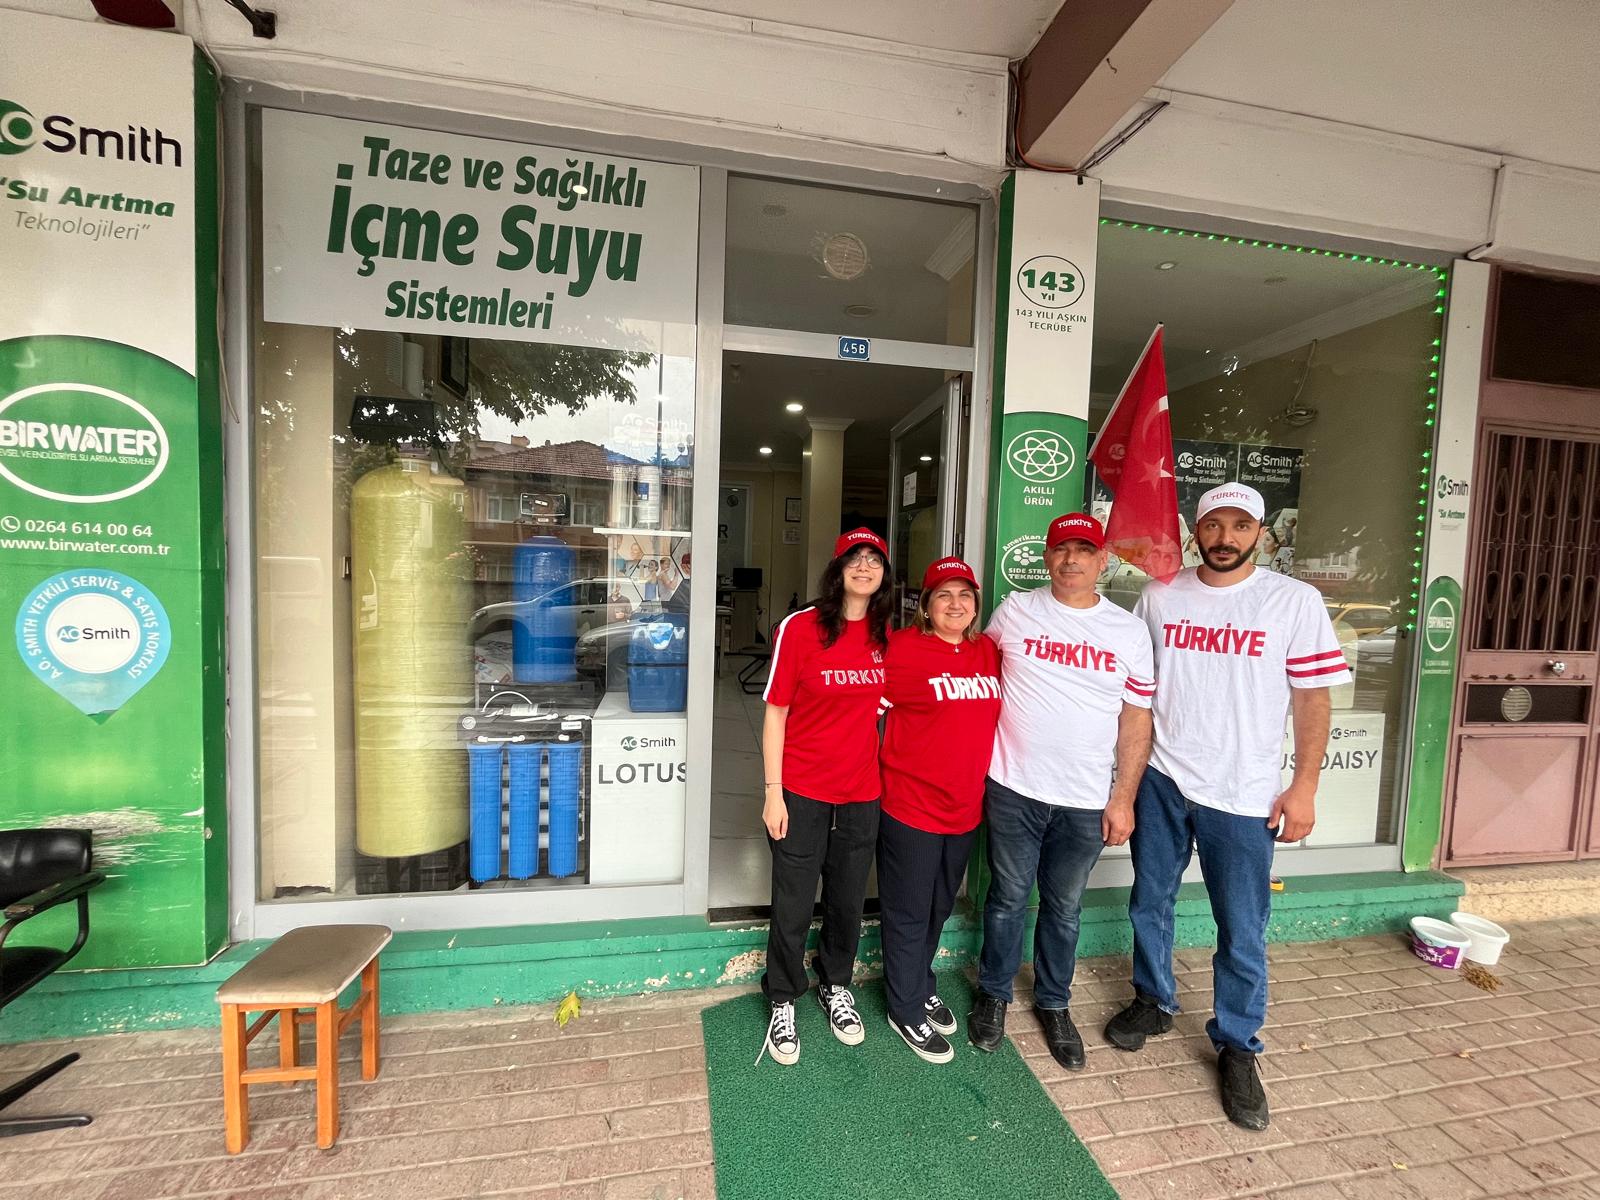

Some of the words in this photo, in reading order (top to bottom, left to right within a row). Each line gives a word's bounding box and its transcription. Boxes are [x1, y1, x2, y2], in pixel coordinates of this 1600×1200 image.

[43, 115, 182, 168] Smith
[363, 135, 452, 185] Taze
[463, 157, 504, 191] ve
[513, 156, 647, 211] Sağlıklı
[58, 186, 176, 217] Arıtma
[327, 163, 480, 277] İçme
[496, 204, 643, 298] Suyu
[1022, 269, 1075, 292] 143
[385, 280, 555, 330] Sistemleri
[1041, 292, 1055, 301] Yıl
[1016, 308, 1033, 317] 143
[1036, 310, 1054, 320] YILI
[1057, 313, 1087, 323] AŞKIN
[1029, 321, 1072, 333] TECRÜBE
[843, 342, 866, 354] 45B
[1195, 455, 1227, 468] Smith
[1262, 454, 1292, 468] Smith
[1023, 485, 1055, 495] AKILLI
[1024, 495, 1053, 506] ÜRÜN
[25, 520, 67, 534] 0264
[72, 523, 103, 535] 614
[107, 524, 128, 536] 00
[132, 525, 153, 538] 64
[0, 538, 171, 556] www.birwater.com.tr
[71, 575, 121, 592] SERVİS
[27, 577, 70, 616] YETKİLİ
[121, 587, 135, 599] &
[132, 596, 160, 628] SATIŞ
[23, 619, 42, 657] SMITH
[82, 628, 131, 640] Smith
[1163, 619, 1266, 657] TÜRKİYE
[127, 632, 160, 680] NOKTASI
[1023, 634, 1117, 673] TÜRKİYE
[640, 737, 676, 748] Smith
[1344, 729, 1367, 738] Smith
